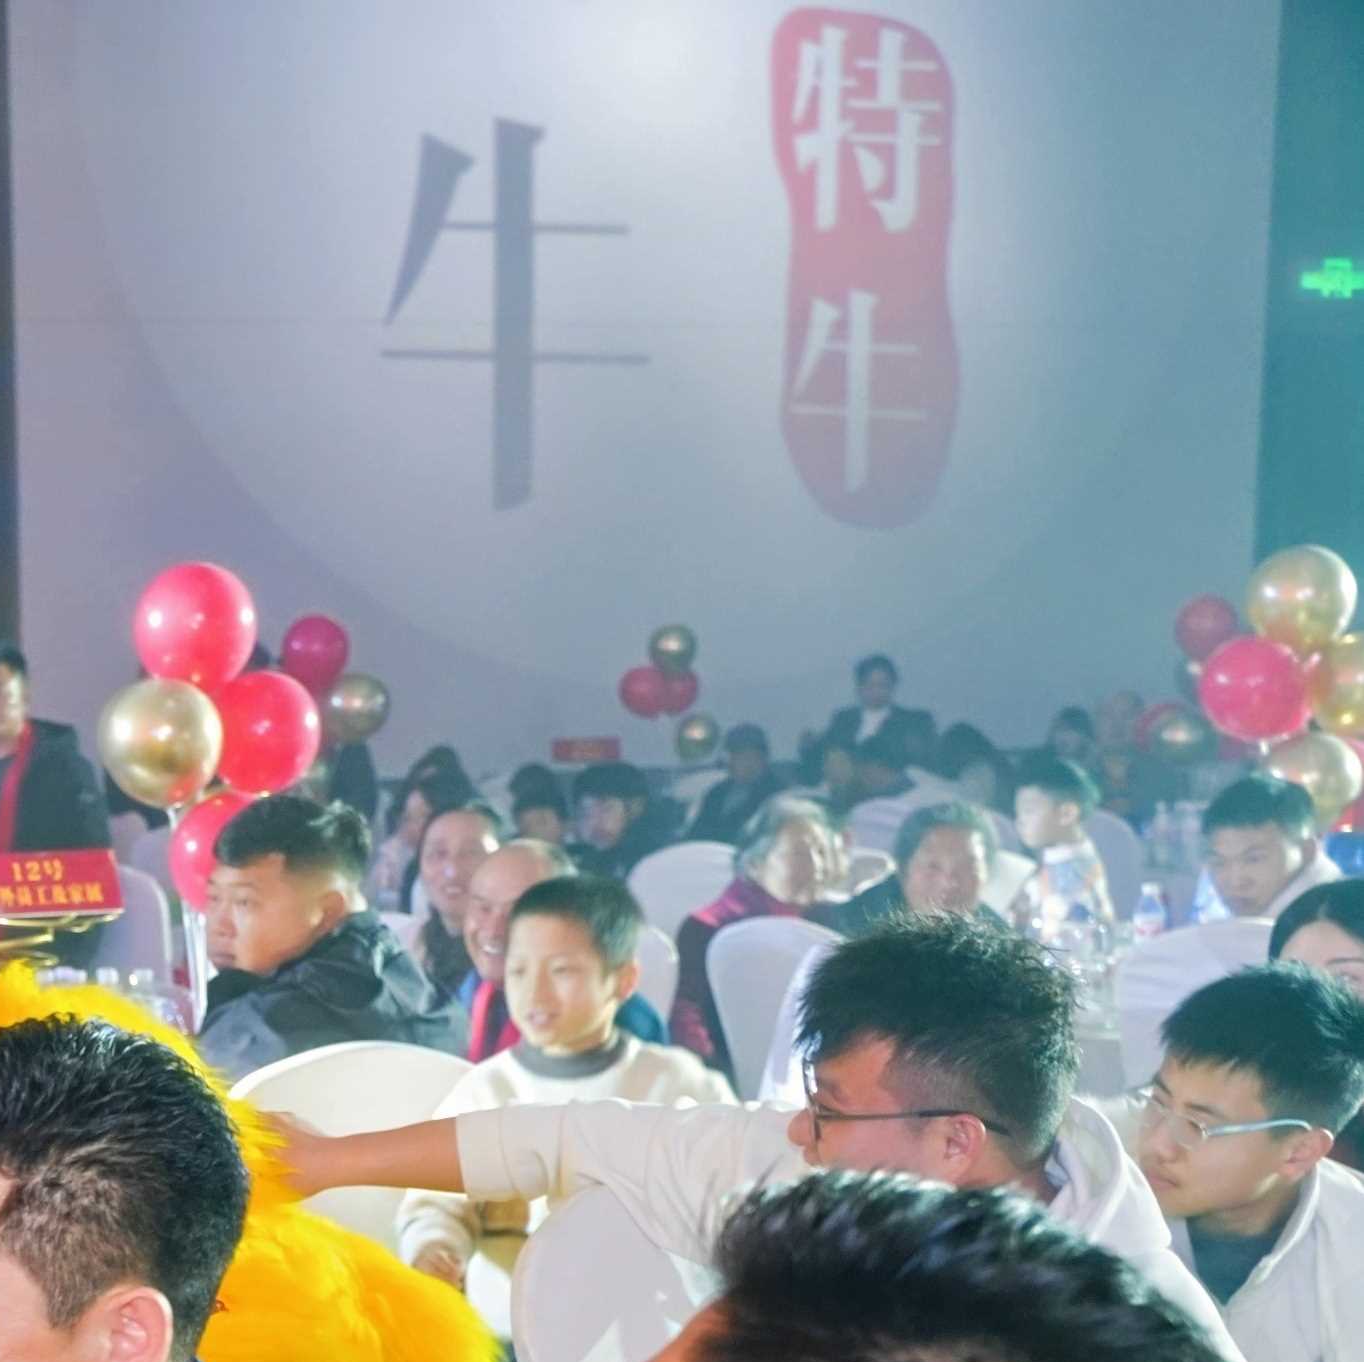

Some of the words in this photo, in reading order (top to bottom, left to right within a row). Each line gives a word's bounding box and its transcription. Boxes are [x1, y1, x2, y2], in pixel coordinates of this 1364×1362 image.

[381, 116, 651, 511] 牛
[790, 25, 943, 493] 特牛
[10, 857, 64, 882] 12号
